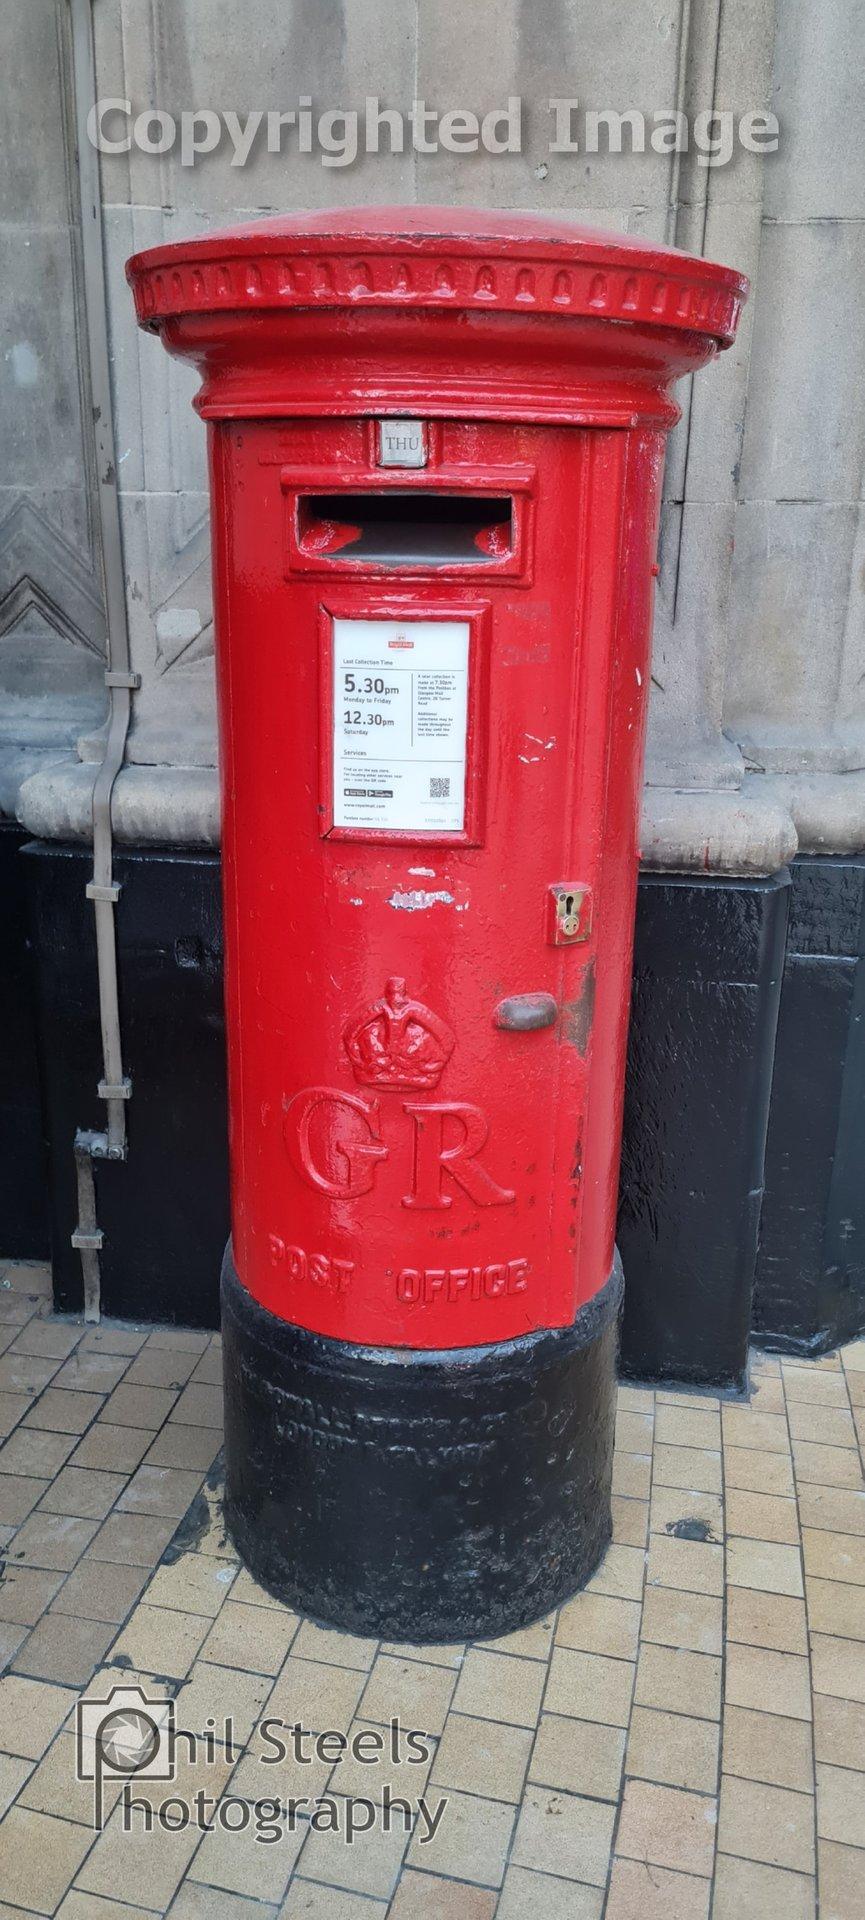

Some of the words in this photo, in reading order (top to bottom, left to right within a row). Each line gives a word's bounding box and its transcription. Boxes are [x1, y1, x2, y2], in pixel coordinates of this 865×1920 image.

[385, 436, 420, 450] THU
[344, 674, 399, 695] 5.30pm
[344, 710, 395, 727] 12.30pm
[282, 1085, 516, 1210] GR
[268, 1233, 356, 1295] POST
[395, 1257, 530, 1304] OFFICE
